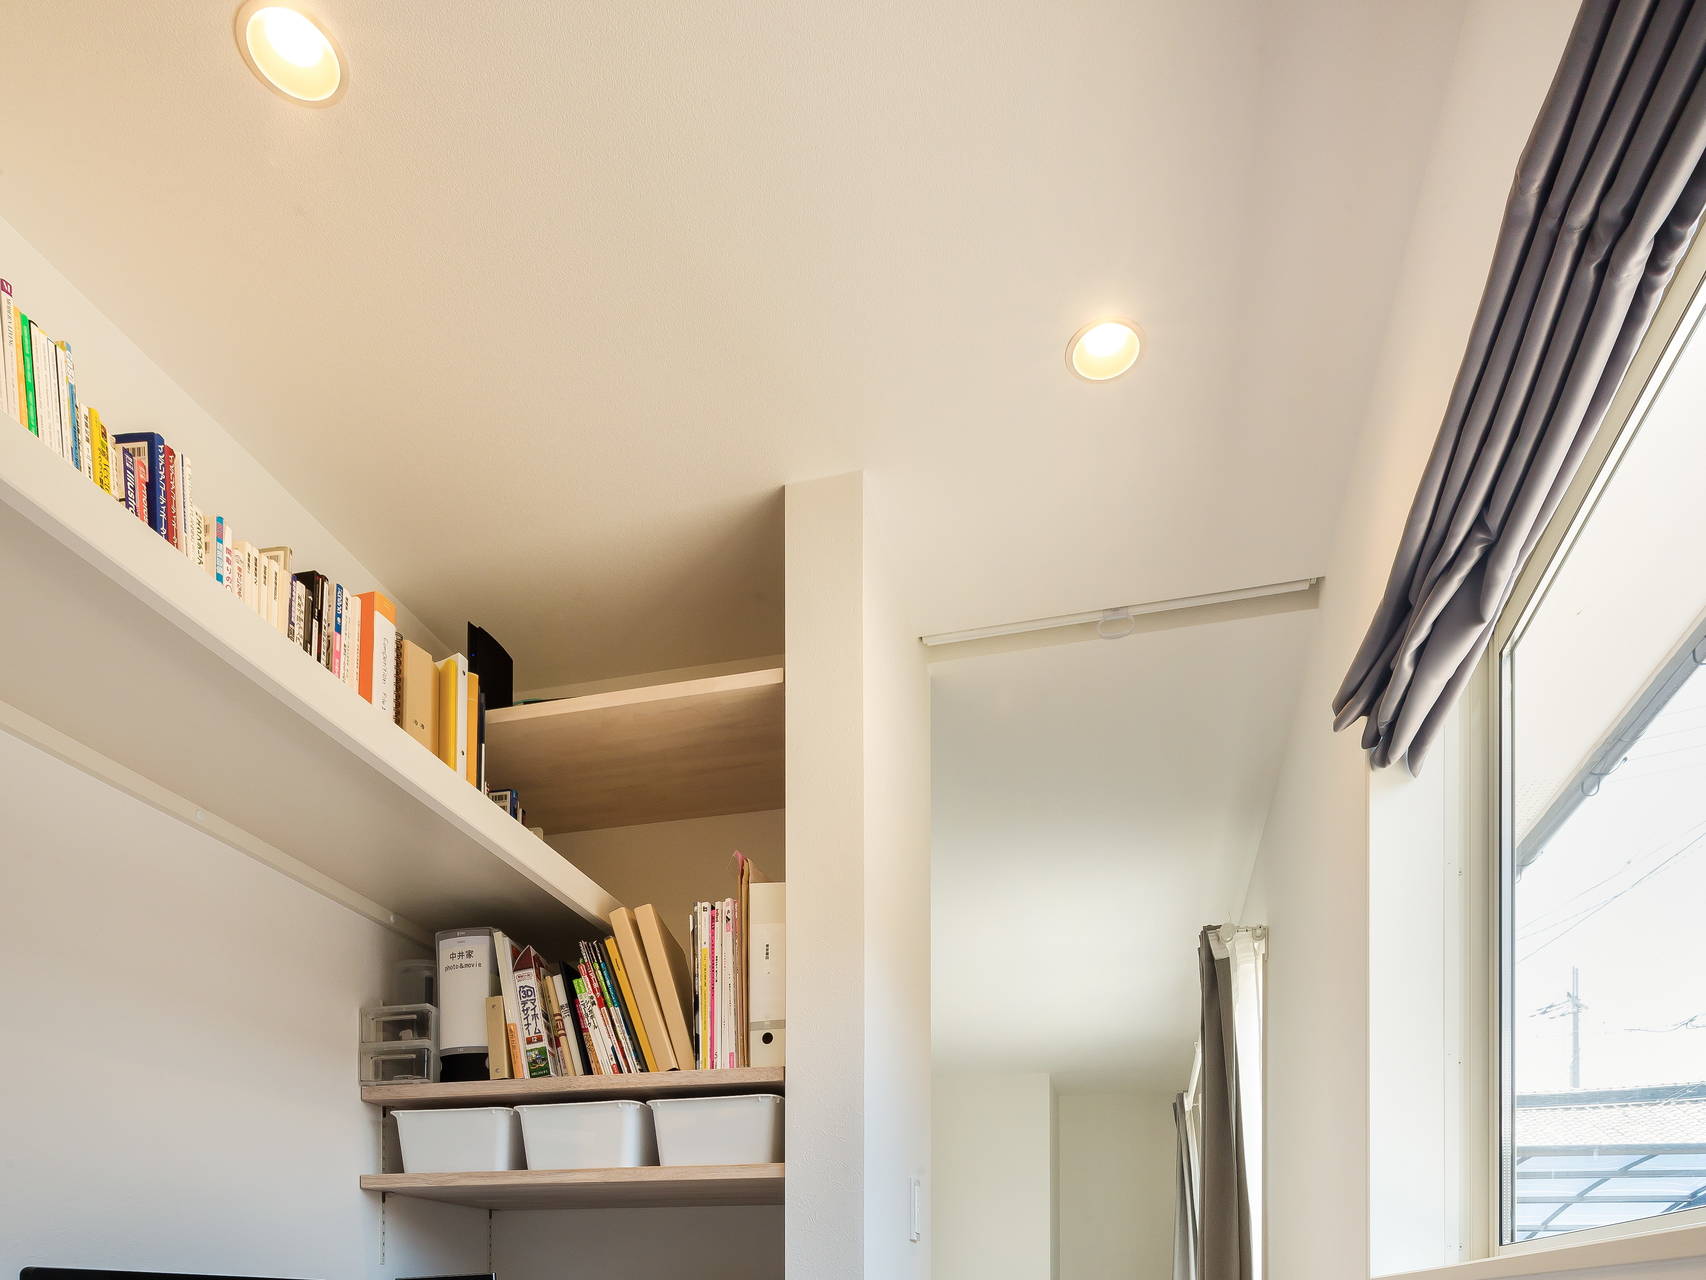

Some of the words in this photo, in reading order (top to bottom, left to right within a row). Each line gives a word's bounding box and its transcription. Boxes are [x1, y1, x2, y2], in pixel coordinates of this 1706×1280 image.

[449, 949, 474, 960] 中井家
[521, 988, 533, 999] 3D
[520, 1000, 532, 1036] デザイナー
[530, 999, 542, 1035] マイホーム
